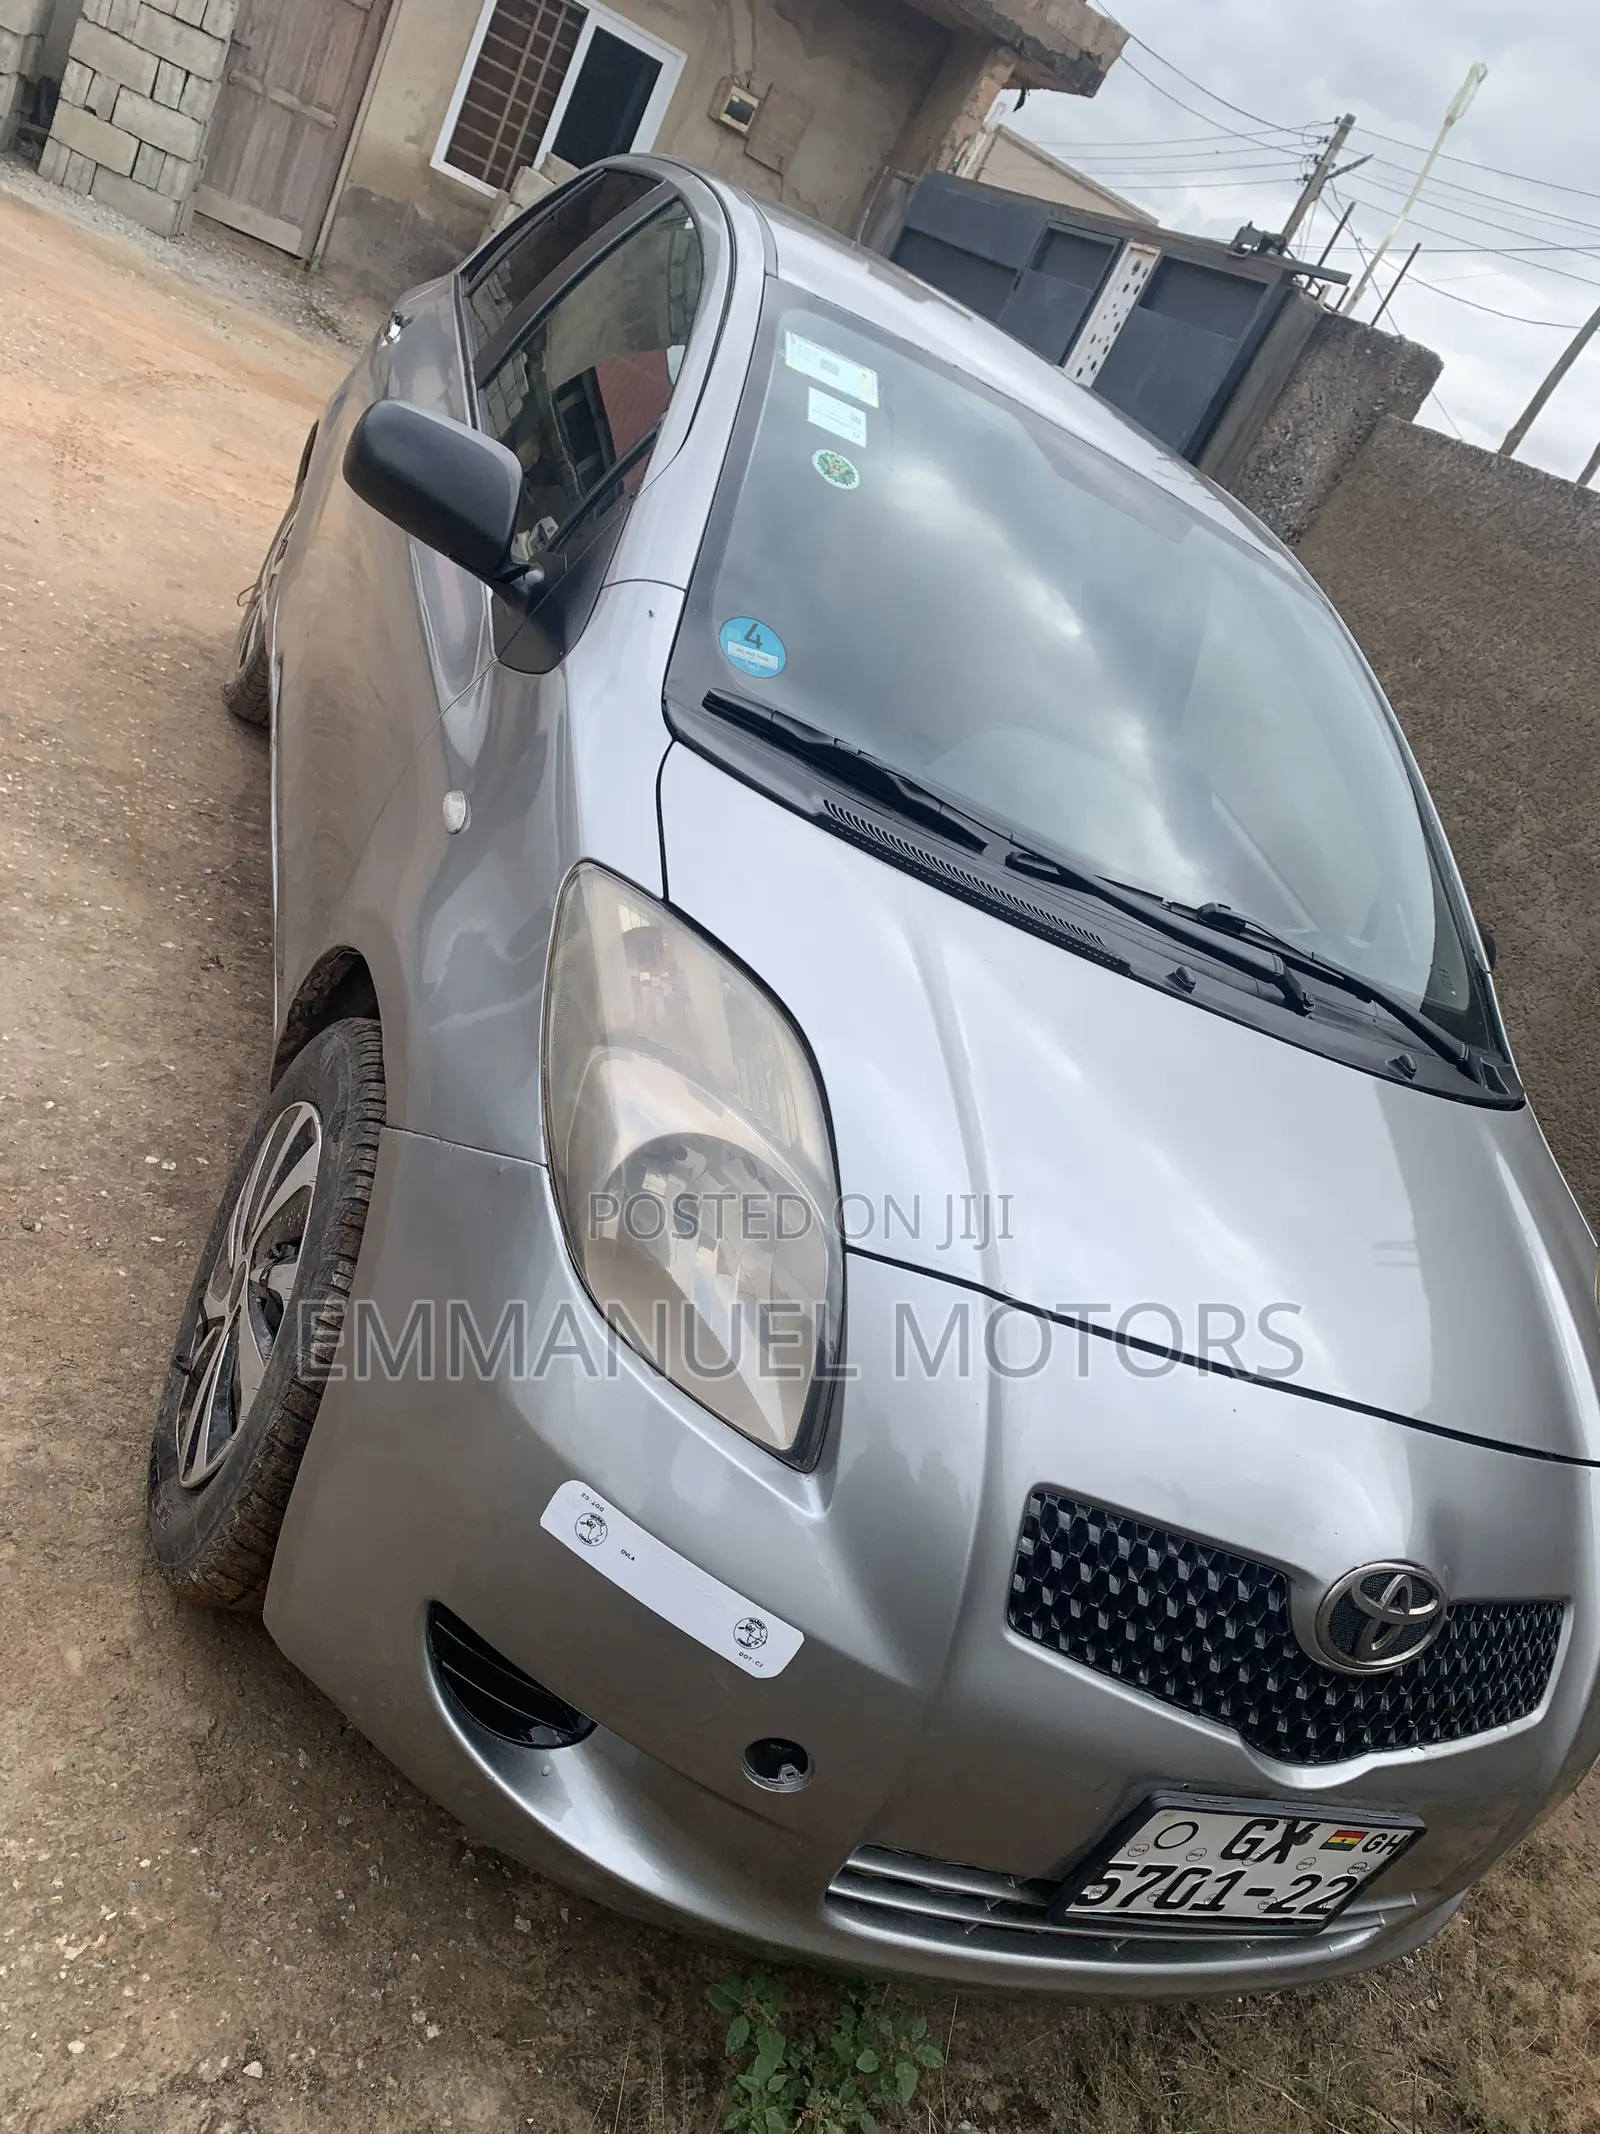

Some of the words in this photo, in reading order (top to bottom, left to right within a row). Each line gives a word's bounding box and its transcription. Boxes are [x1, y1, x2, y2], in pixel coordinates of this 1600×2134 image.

[744, 622, 763, 649] 4
[620, 1549, 635, 1561] DVLA
[1220, 1818, 1321, 1864] GX
[1362, 1832, 1409, 1856] GH
[1075, 1863, 1358, 1915] 5701-22
